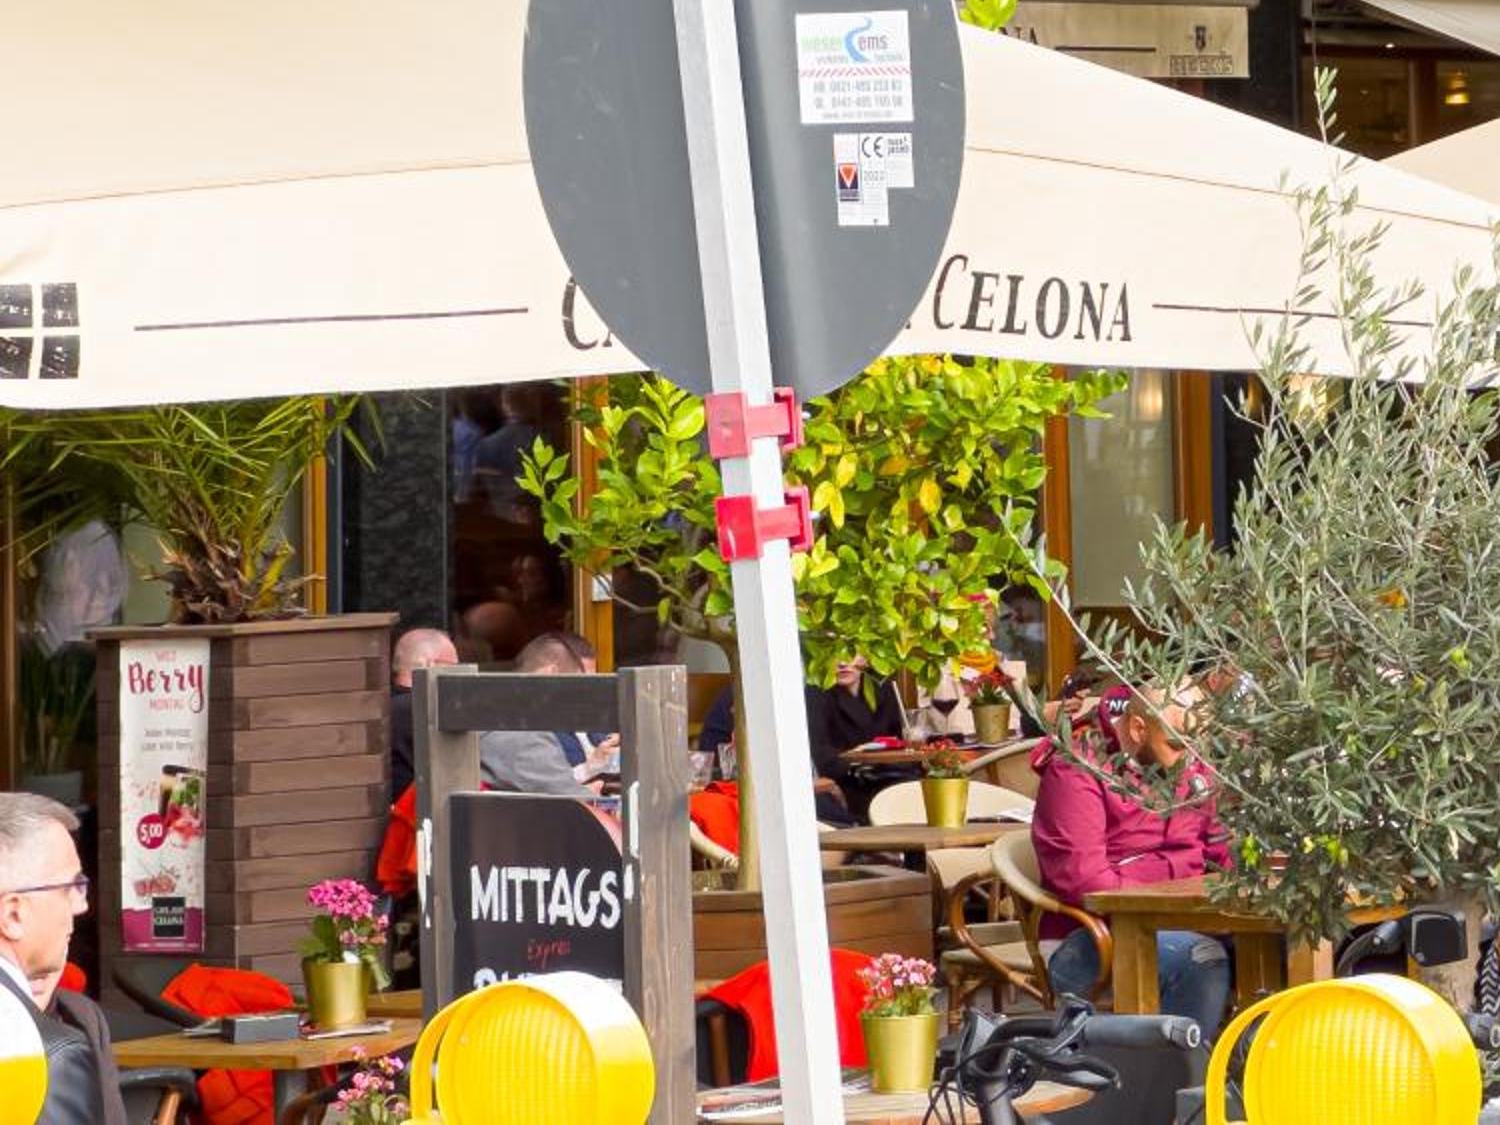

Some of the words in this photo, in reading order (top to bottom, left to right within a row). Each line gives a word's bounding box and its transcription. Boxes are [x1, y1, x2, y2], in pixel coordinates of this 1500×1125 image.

[858, 34, 888, 51] ems
[862, 136, 884, 158] CE
[933, 253, 1133, 342] CELONA
[128, 662, 204, 713] Berry
[470, 864, 621, 930] MITTAGS
